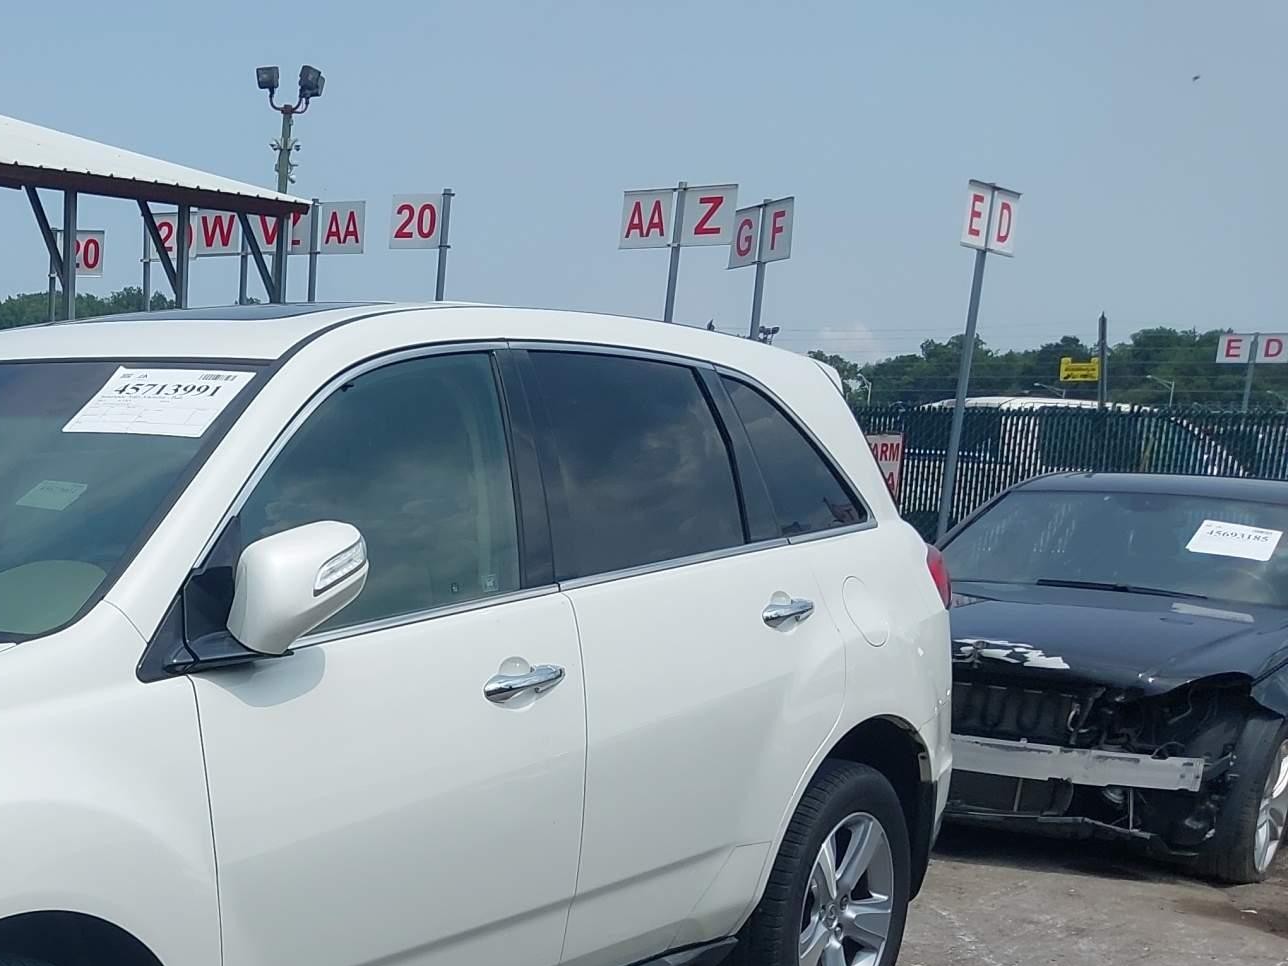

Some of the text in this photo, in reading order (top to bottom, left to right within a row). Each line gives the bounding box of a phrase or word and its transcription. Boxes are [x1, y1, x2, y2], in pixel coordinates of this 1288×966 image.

[201, 215, 236, 247] W
[324, 211, 360, 244] AA
[394, 203, 437, 239] 20
[625, 196, 724, 238] AA Z
[736, 210, 786, 257] G F
[968, 194, 1011, 243] E D
[1225, 338, 1283, 358] E D
[114, 383, 222, 397] 45713991
